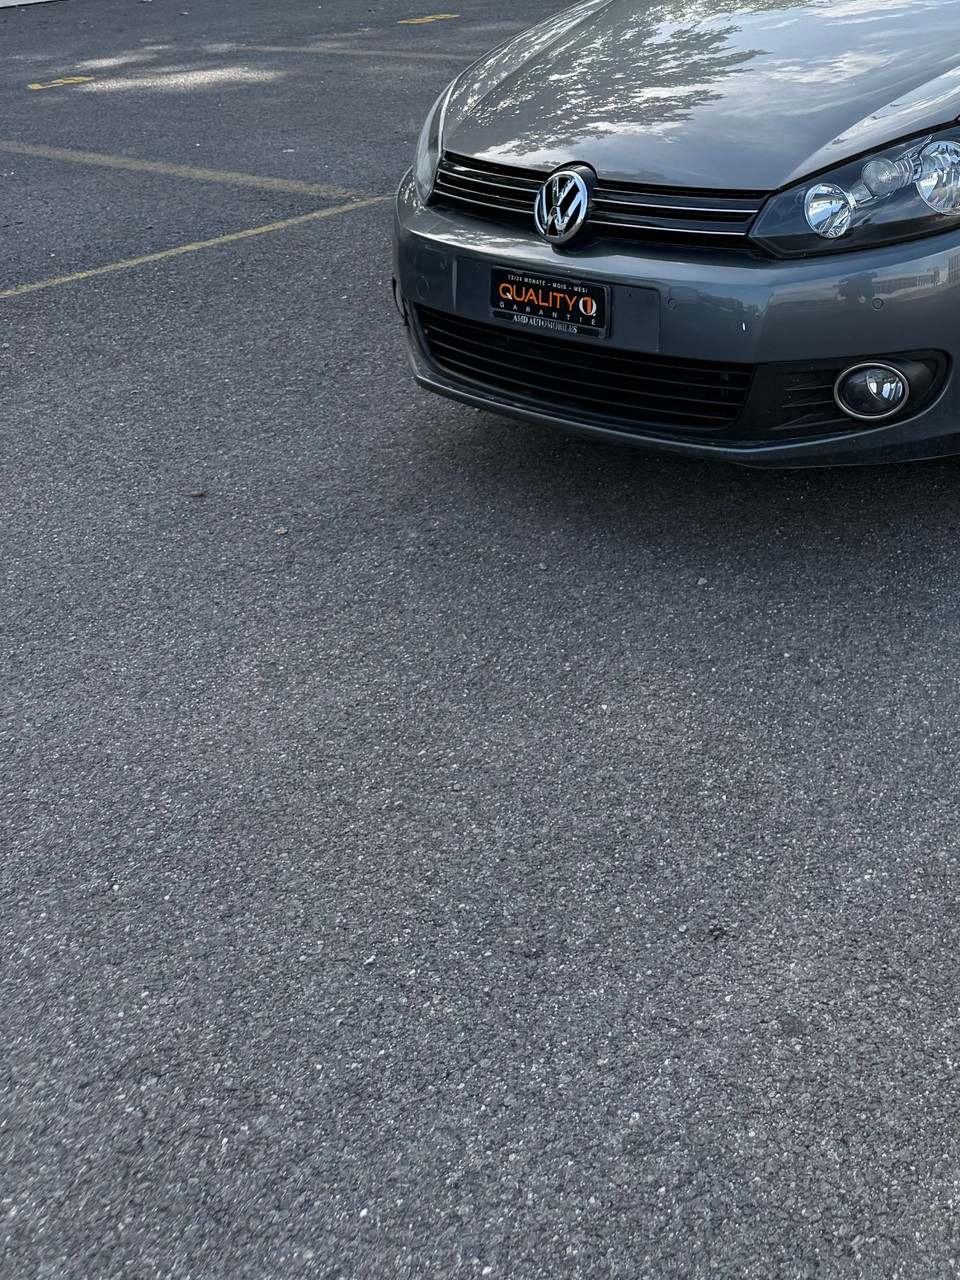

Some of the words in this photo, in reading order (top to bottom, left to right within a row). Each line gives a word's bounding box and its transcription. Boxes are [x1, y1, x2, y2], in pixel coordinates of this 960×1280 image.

[524, 277, 546, 286] MONATE
[499, 283, 578, 311] QUALITY
[500, 301, 596, 326] GARANTIE
[513, 314, 528, 324] AMD
[529, 317, 578, 334] AUTOMOBILES
